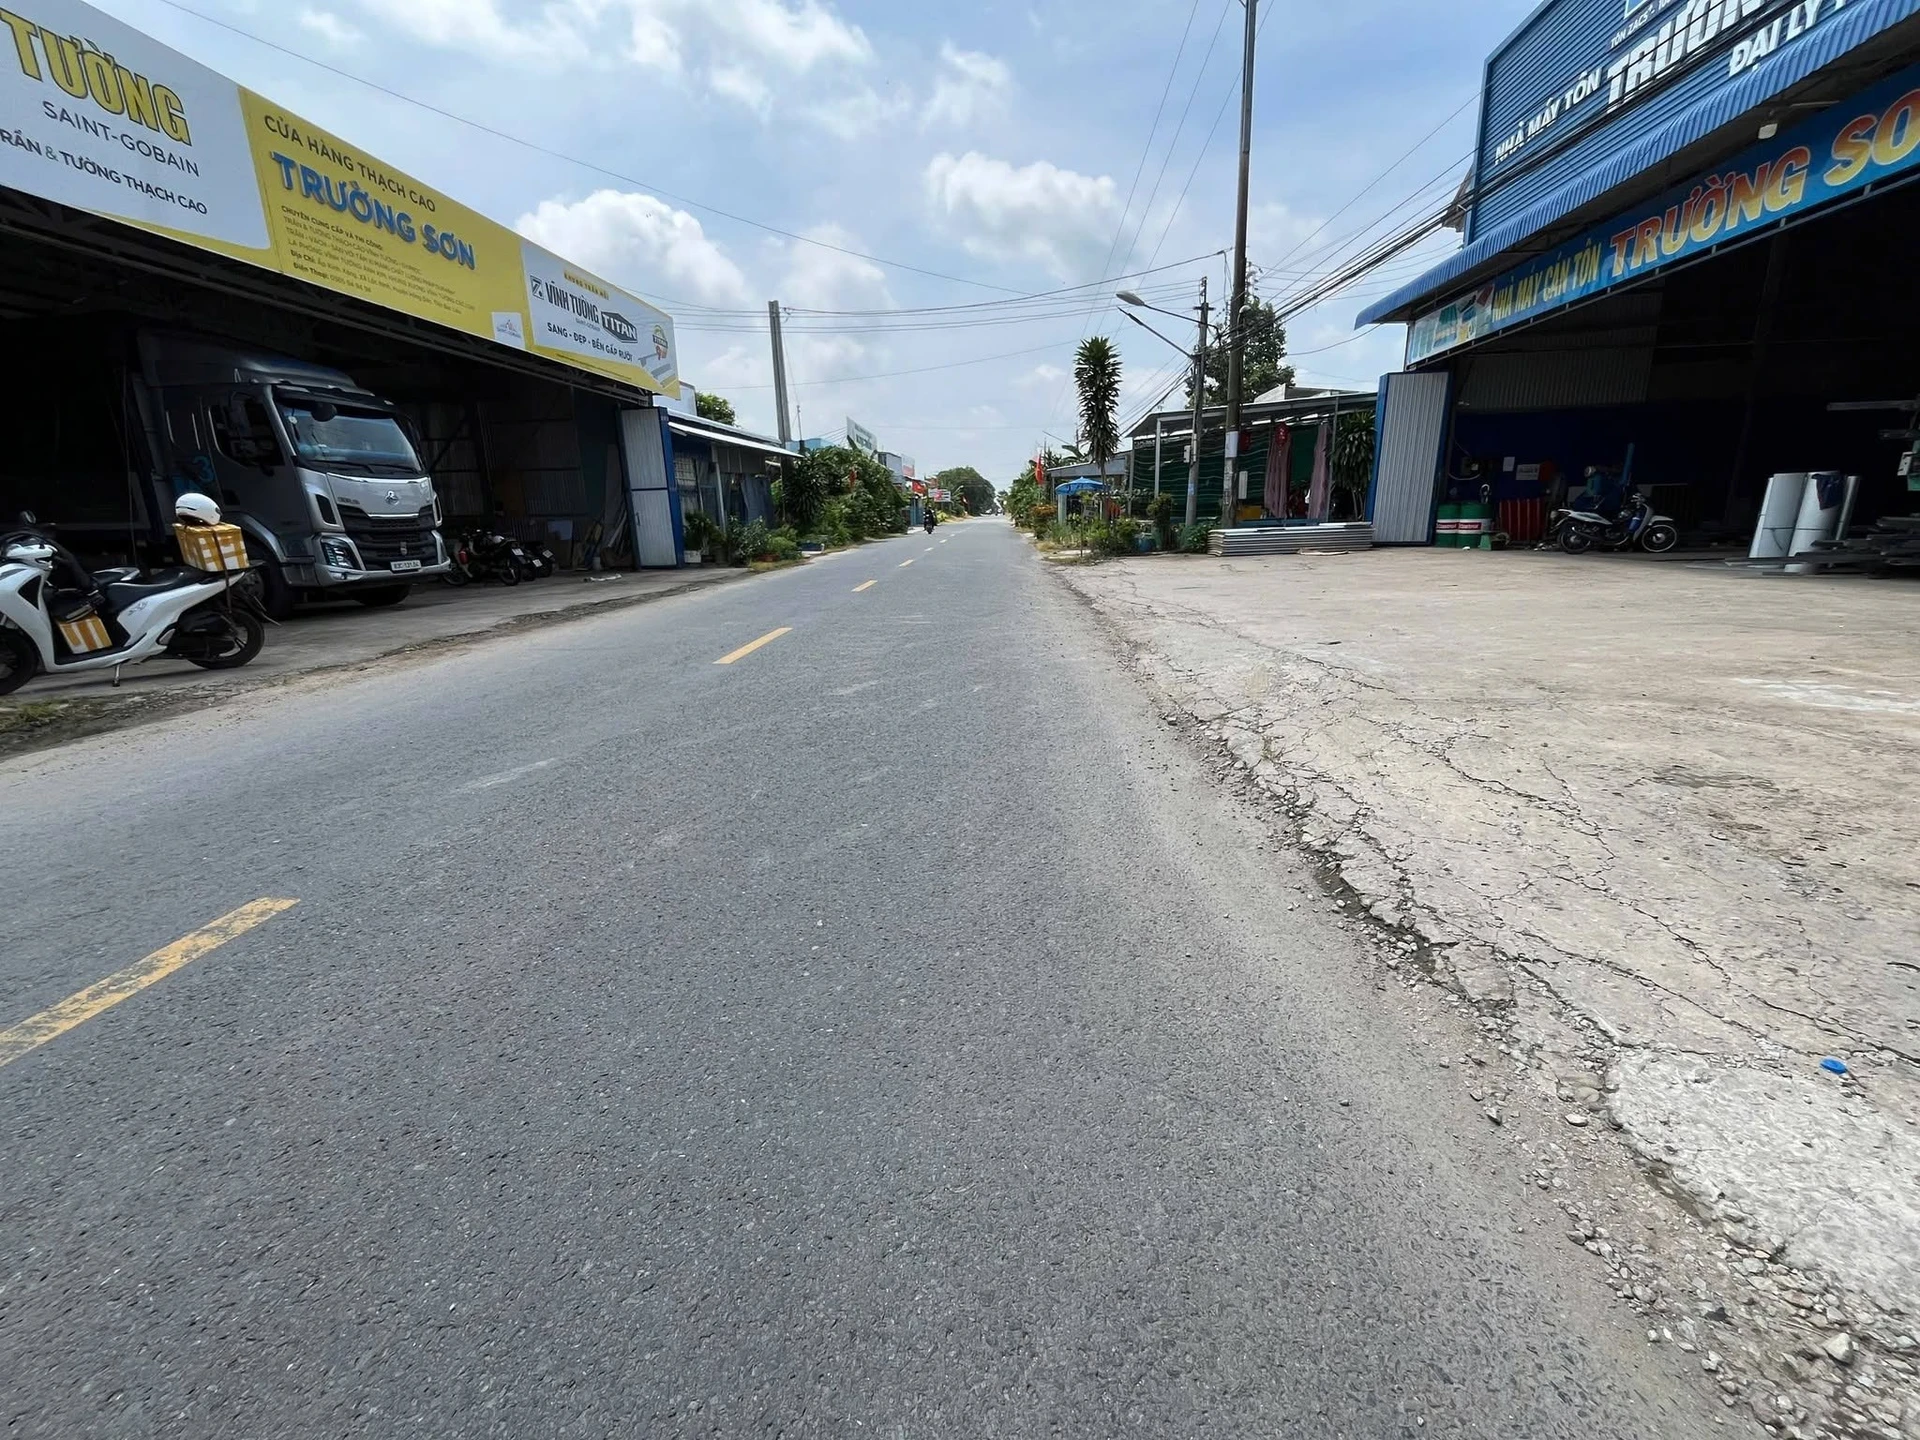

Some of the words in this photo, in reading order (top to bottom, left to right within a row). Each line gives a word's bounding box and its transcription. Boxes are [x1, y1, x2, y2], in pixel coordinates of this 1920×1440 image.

[0, 7, 192, 147] TƯỜNG
[1729, 17, 1783, 77] ĐẠI
[42, 100, 200, 177] SAINT-GOBAIN
[1527, 97, 1562, 142] MÁY
[1564, 67, 1603, 111] TÔN
[0, 128, 43, 156] RẦN
[45, 146, 58, 162] &
[58, 150, 121, 184] TƯỜNG
[122, 174, 176, 204] THẠCH
[177, 195, 208, 215] CAO
[264, 115, 304, 147] CỬA
[306, 136, 354, 172] HÀNG
[357, 162, 407, 199] THẠCH
[409, 189, 437, 213] CAO
[271, 150, 417, 244] TRƯỜNG
[420, 224, 476, 271] SƠN
[1491, 276, 1514, 323] NHÀ
[1514, 266, 1543, 313] MÁY
[1573, 240, 1601, 291] TÔN
[1610, 147, 1812, 278] TRƯỜNG
[545, 280, 570, 312] VĨNH
[569, 294, 600, 325] TƯỜNG
[601, 313, 637, 341] TITAN
[546, 322, 568, 338] SANG
[573, 332, 587, 345] ĐẸP
